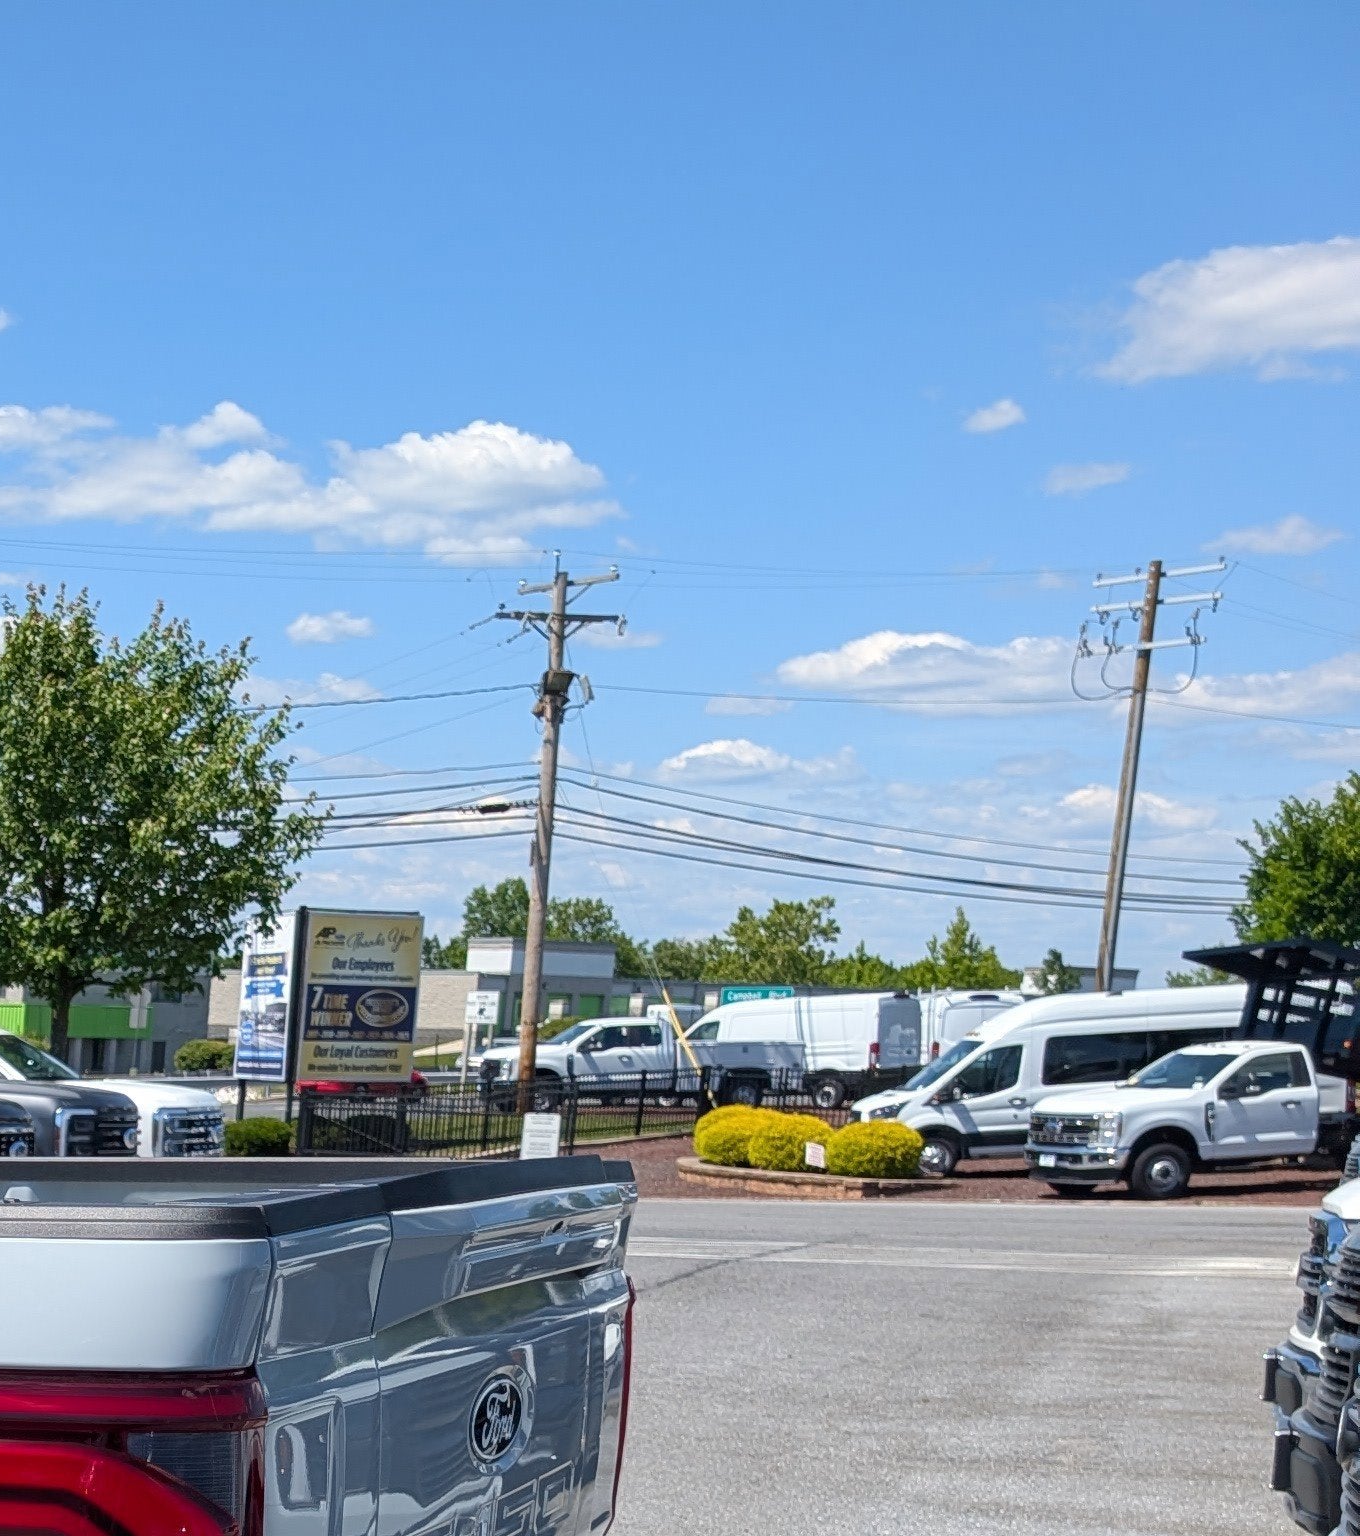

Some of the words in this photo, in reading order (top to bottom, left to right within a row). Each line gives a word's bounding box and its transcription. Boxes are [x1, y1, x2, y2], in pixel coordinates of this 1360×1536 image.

[332, 957, 348, 970] Our
[349, 957, 395, 973] Employees
[311, 986, 324, 1009] 7
[323, 993, 350, 1010] TIME
[310, 1010, 353, 1028] WINNER
[313, 1044, 329, 1058] Our
[330, 1045, 354, 1061] Loyal
[355, 1045, 399, 1060] Customers
[480, 1383, 517, 1456] Ford
